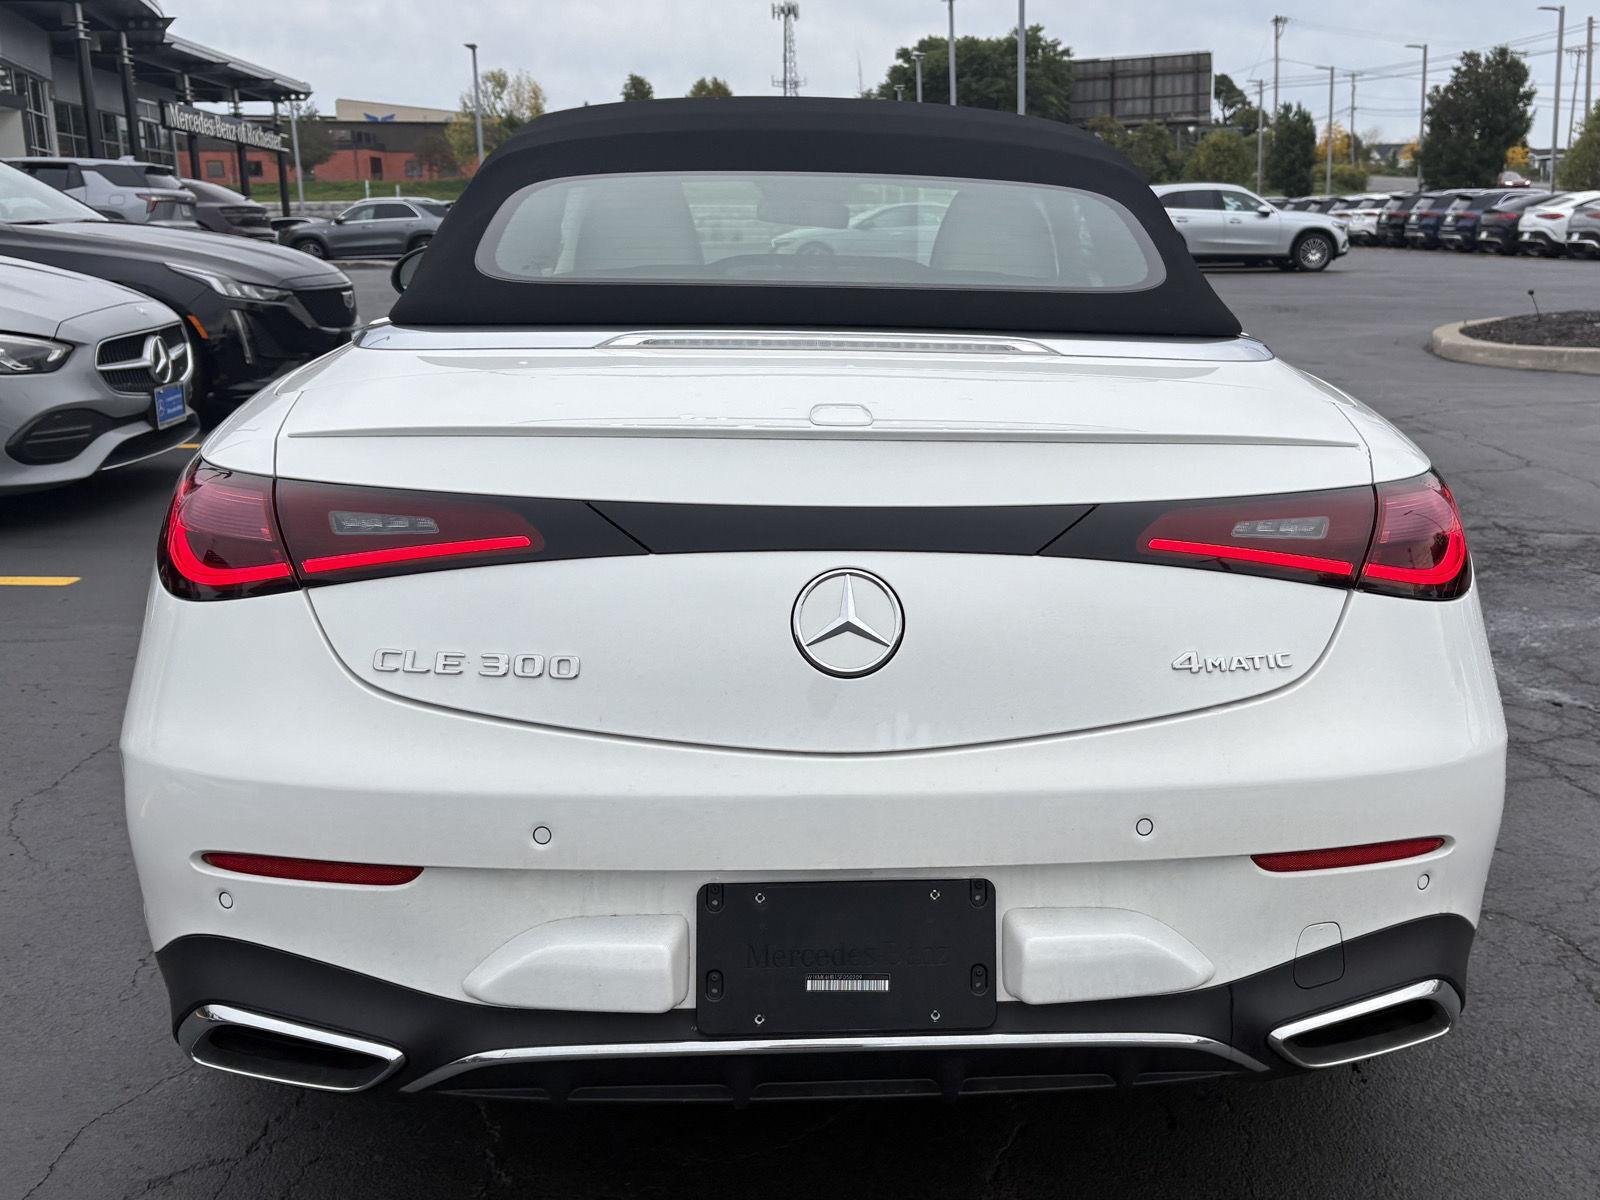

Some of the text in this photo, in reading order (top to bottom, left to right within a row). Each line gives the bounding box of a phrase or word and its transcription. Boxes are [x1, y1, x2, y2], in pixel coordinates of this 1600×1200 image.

[169, 102, 281, 150] Mercedes-Benz of Rochester
[373, 648, 581, 680] CLE 300
[1171, 650, 1293, 674] 4MATIC
